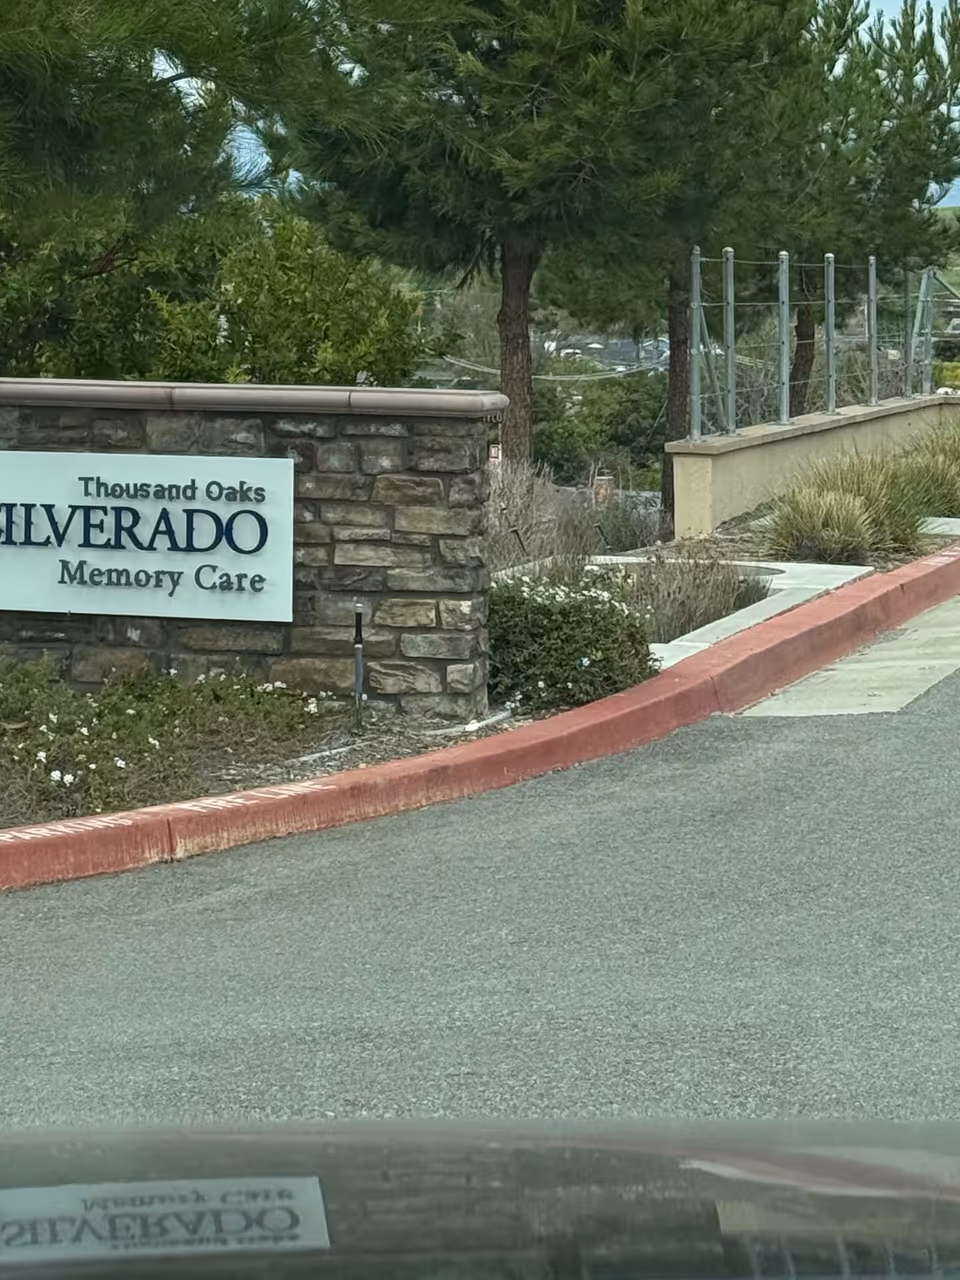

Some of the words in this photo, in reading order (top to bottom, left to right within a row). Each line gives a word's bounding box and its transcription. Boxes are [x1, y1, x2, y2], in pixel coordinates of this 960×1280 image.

[77, 475, 198, 502] Thousand
[205, 480, 267, 503] Oaks
[58, 559, 184, 597] Memory
[194, 564, 267, 593] Care
